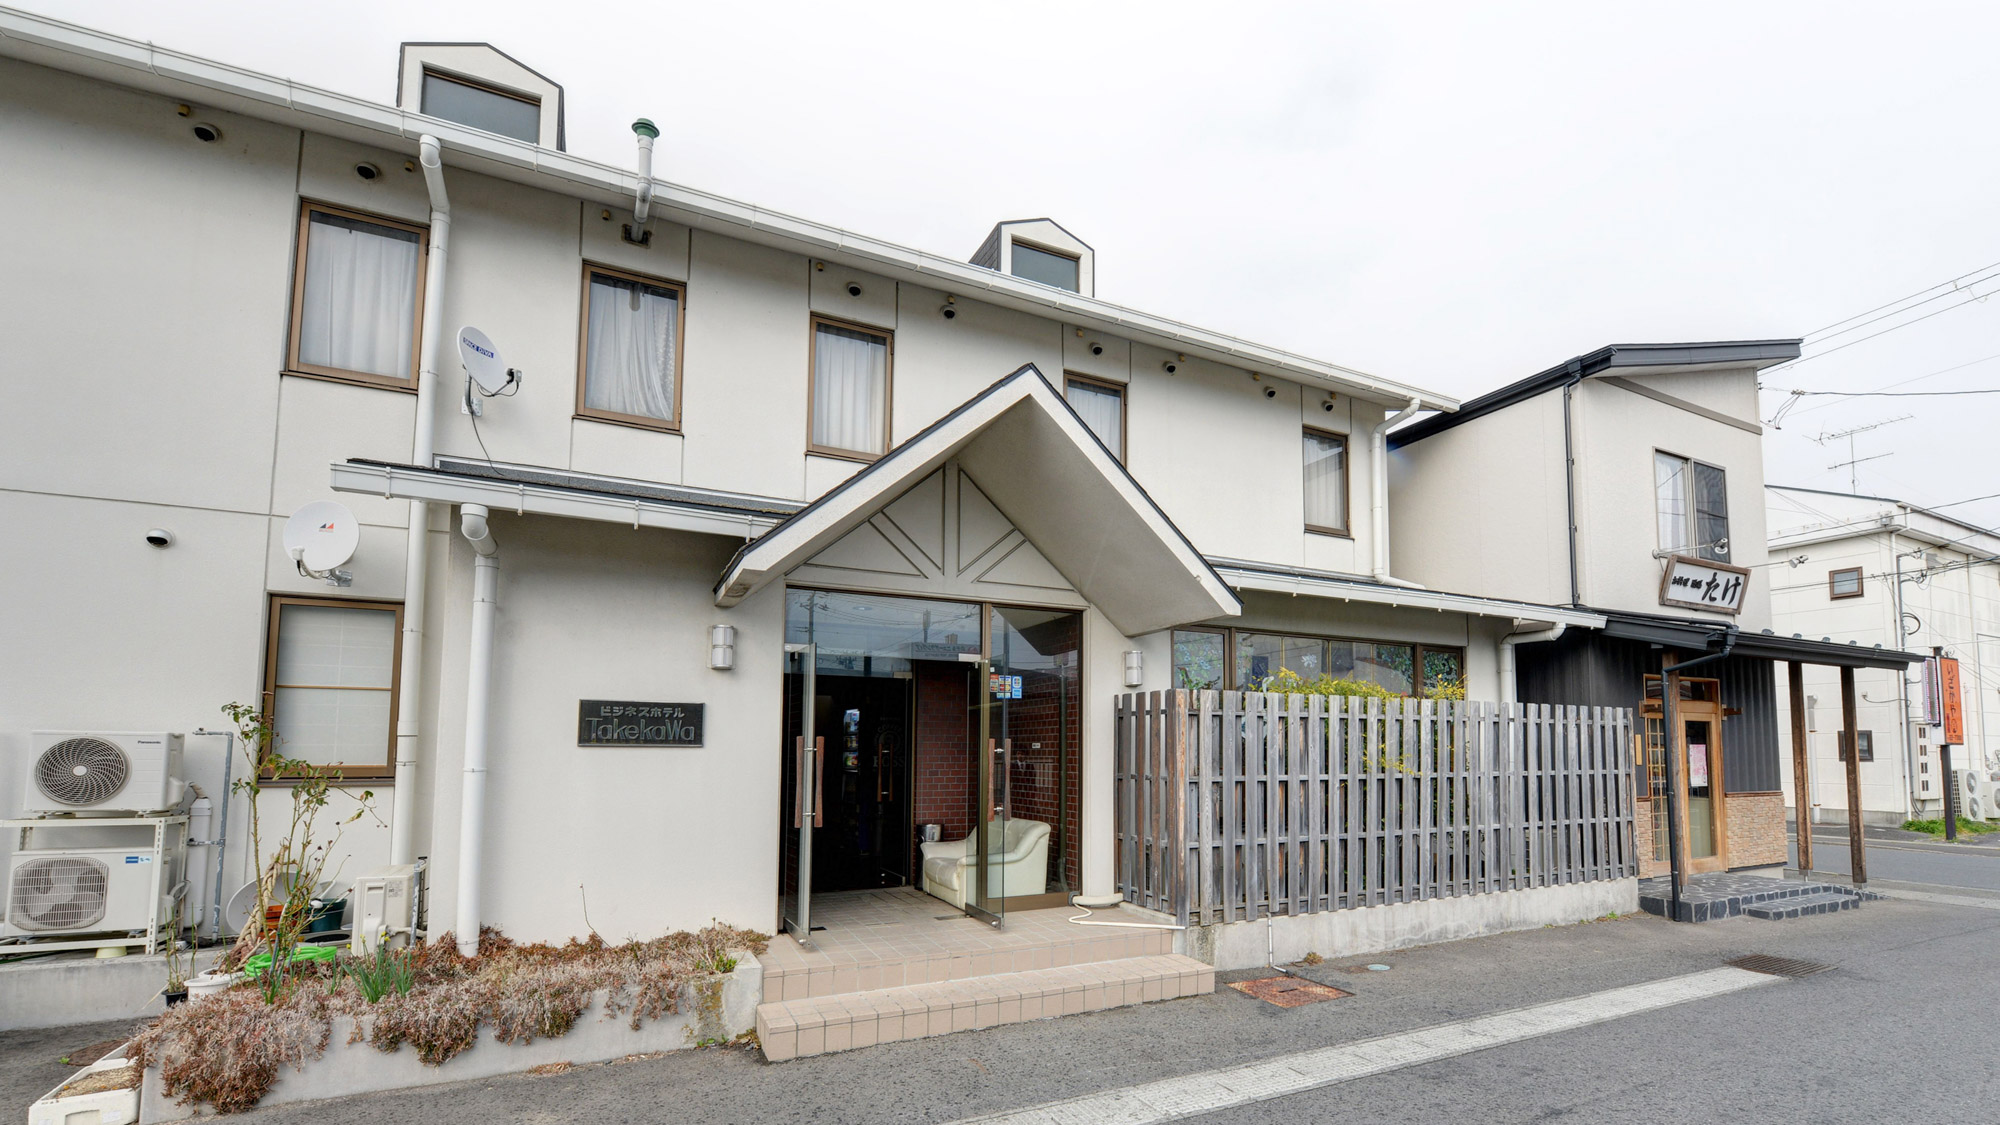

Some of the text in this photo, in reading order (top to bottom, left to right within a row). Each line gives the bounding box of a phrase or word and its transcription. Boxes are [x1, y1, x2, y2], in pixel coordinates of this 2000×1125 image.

[1701, 572, 1742, 605] たけ
[600, 705, 686, 718] ビジネスホテル
